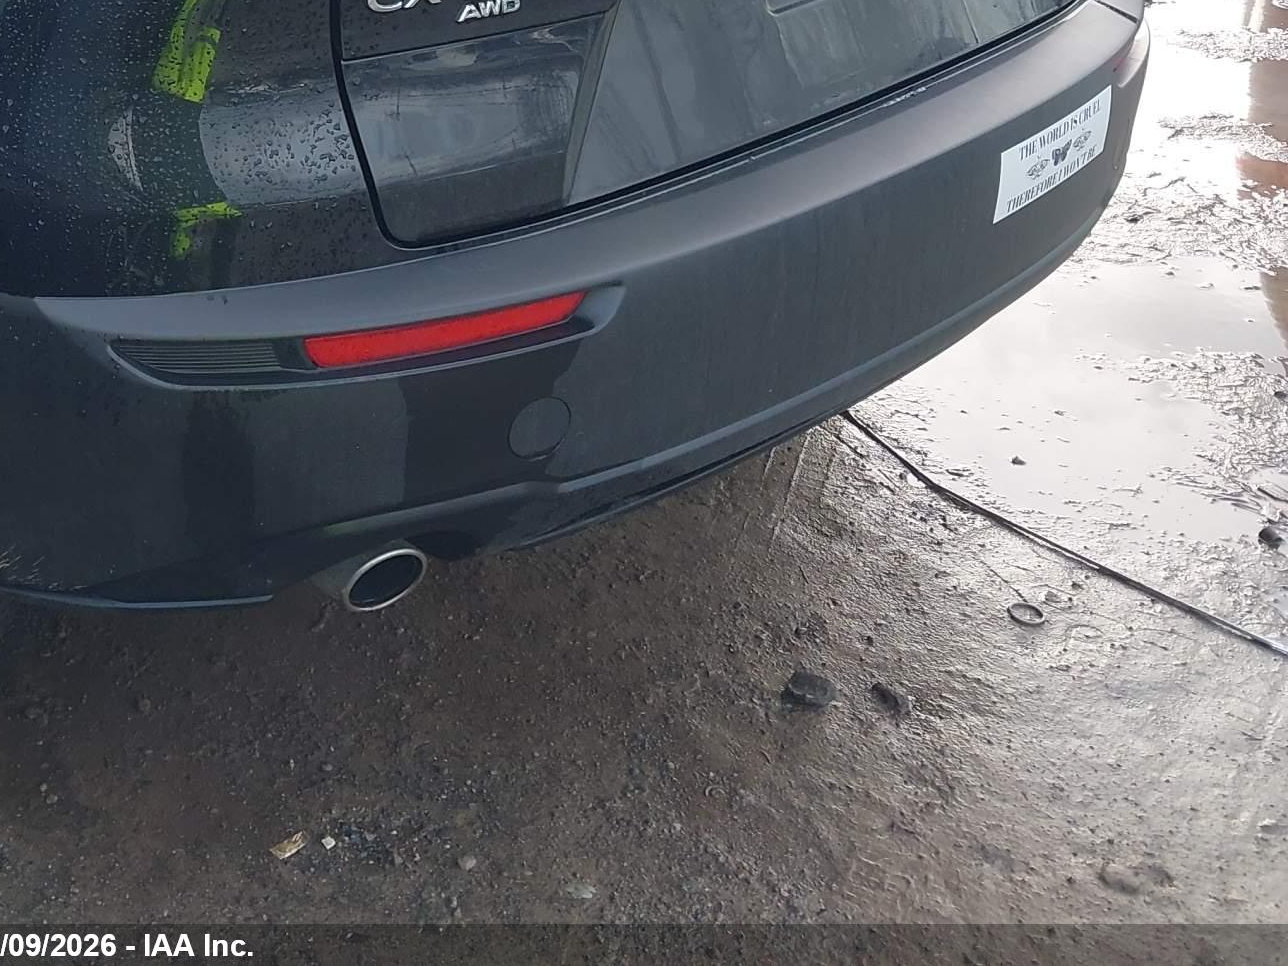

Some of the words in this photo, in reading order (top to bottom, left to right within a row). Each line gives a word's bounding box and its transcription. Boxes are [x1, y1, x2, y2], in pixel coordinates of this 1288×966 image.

[1018, 139, 1039, 162] THE
[1039, 121, 1070, 149] WORLD
[1078, 98, 1100, 126] CRUEL
[1007, 171, 1058, 213] THEREFORE
[1063, 151, 1087, 178] WONT
